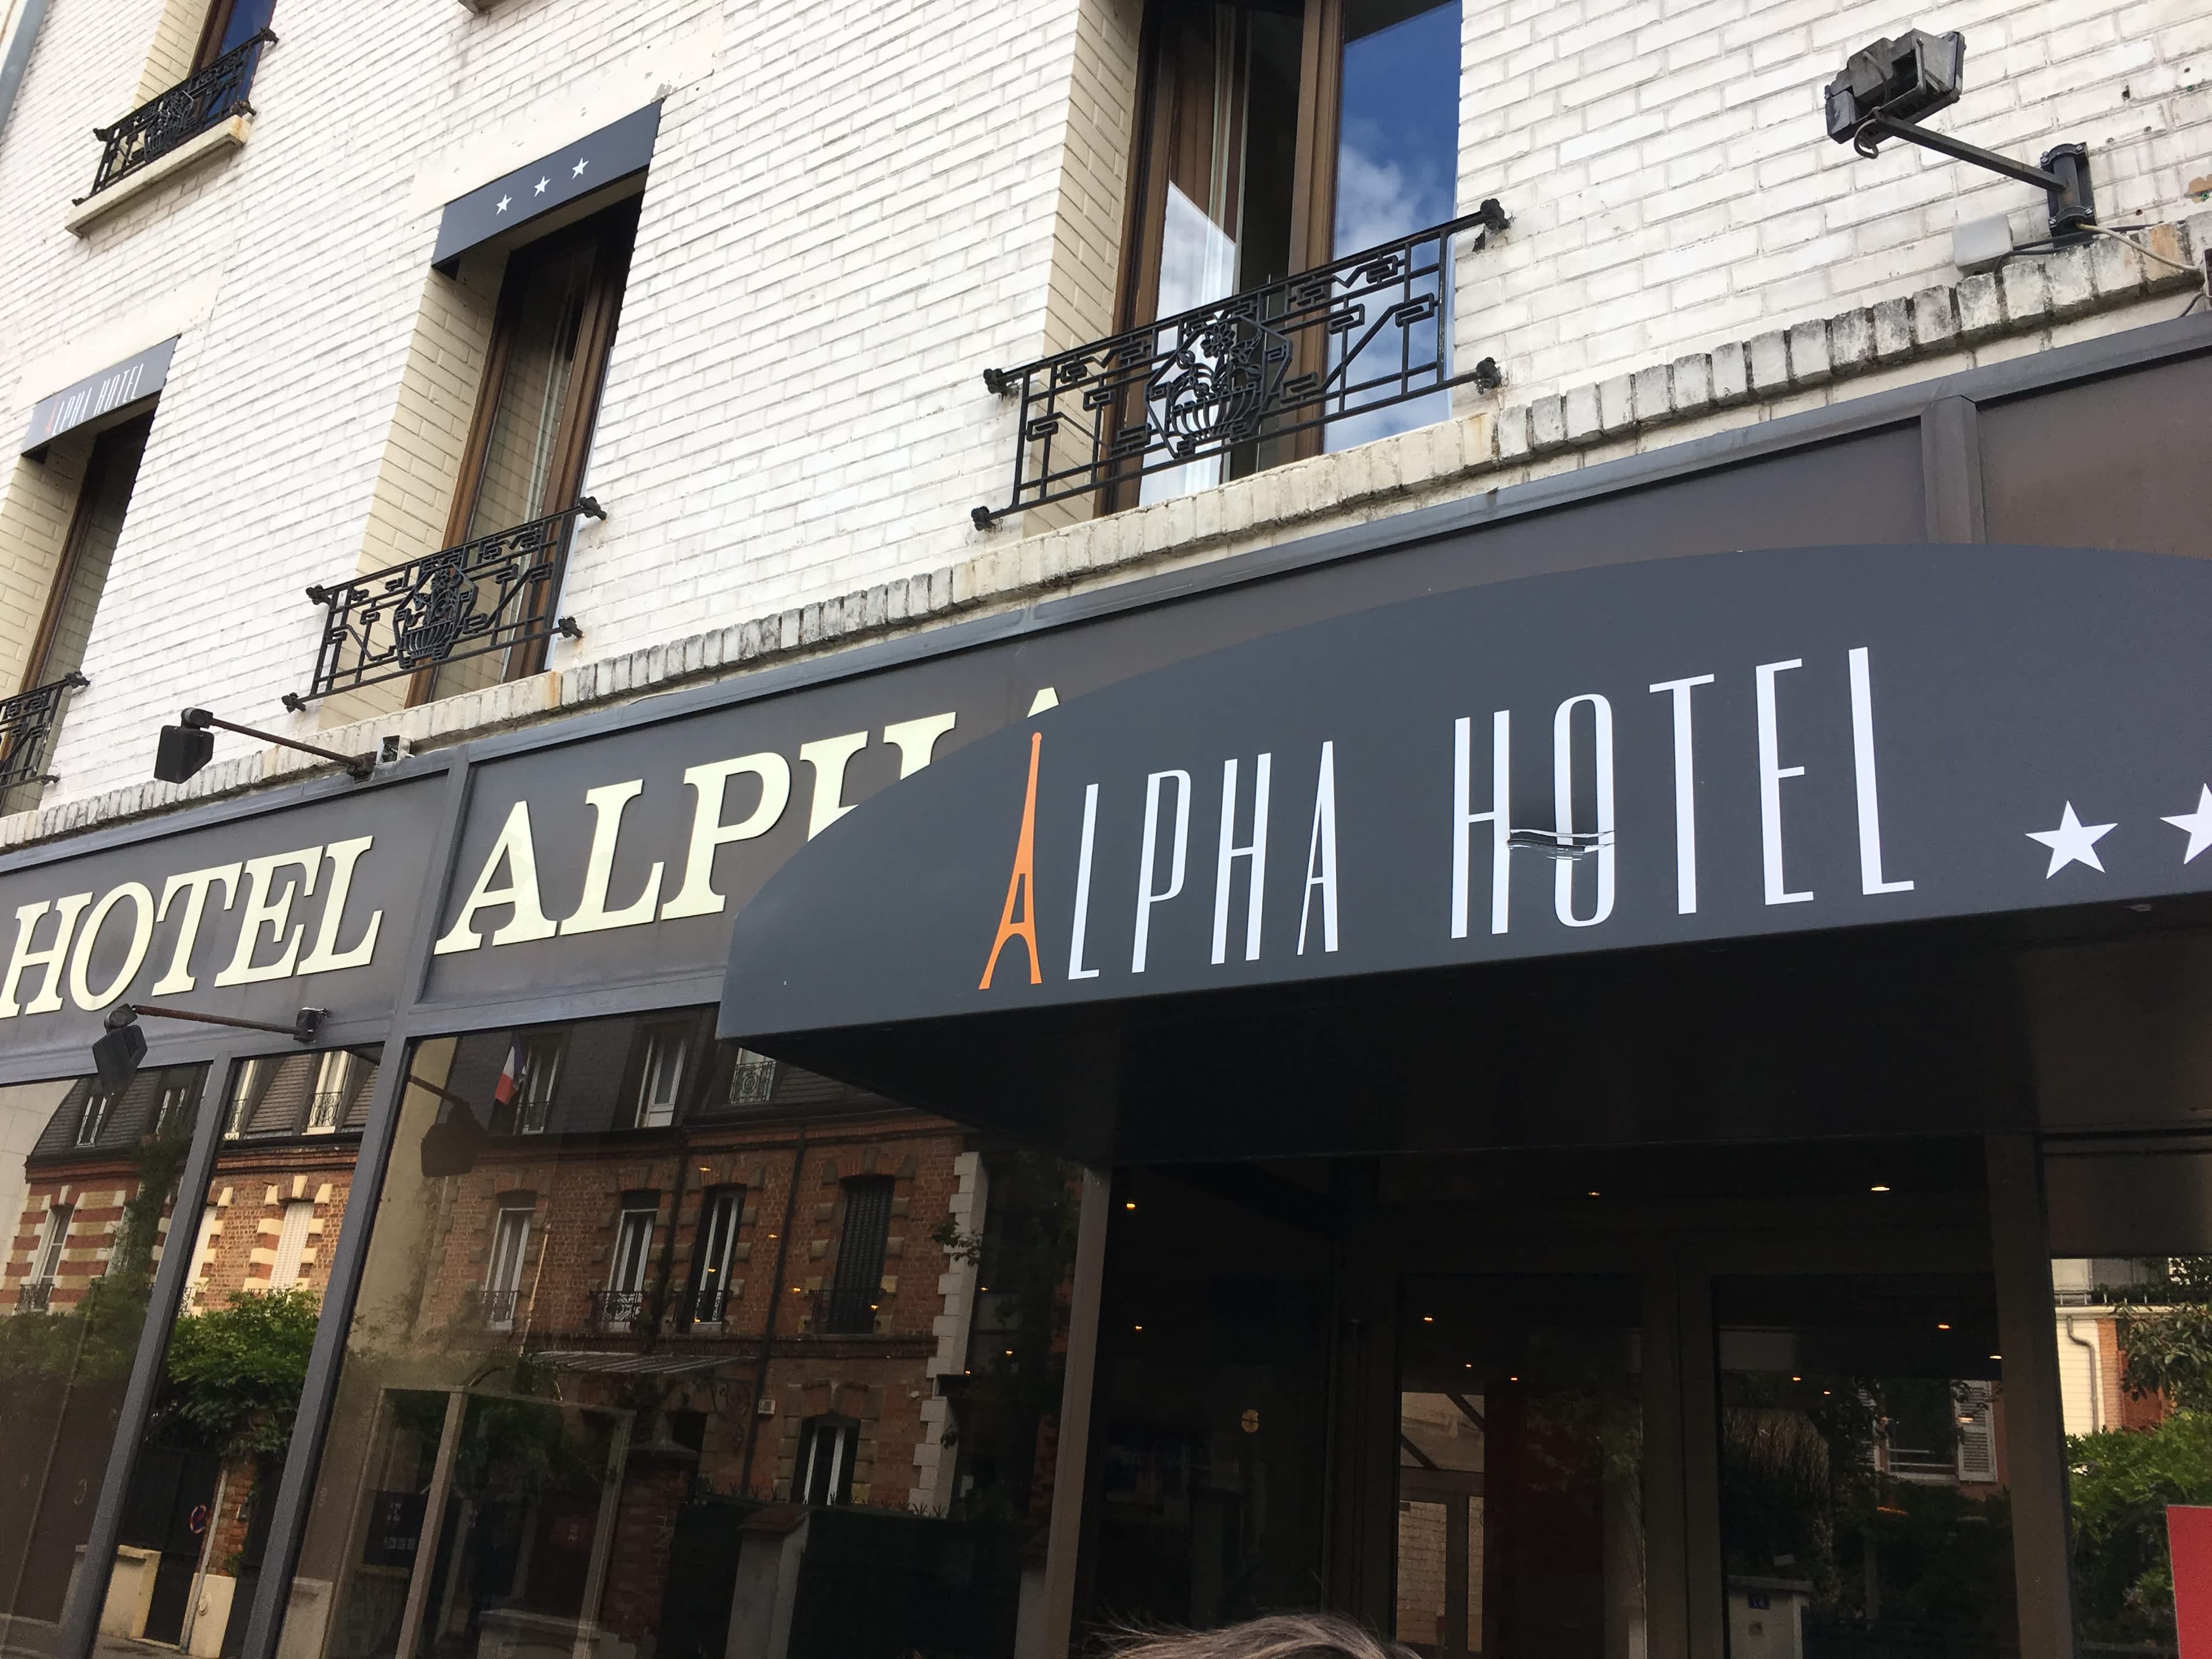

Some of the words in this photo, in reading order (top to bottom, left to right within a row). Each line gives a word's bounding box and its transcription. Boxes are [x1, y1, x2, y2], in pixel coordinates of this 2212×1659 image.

[46, 387, 92, 436] ALPHA
[93, 363, 144, 416] HOTEL
[0, 835, 382, 1018] HOTEL
[434, 687, 1059, 956] ALP
[979, 732, 1338, 990] ALPHA
[1452, 646, 1915, 938] HOTEL
